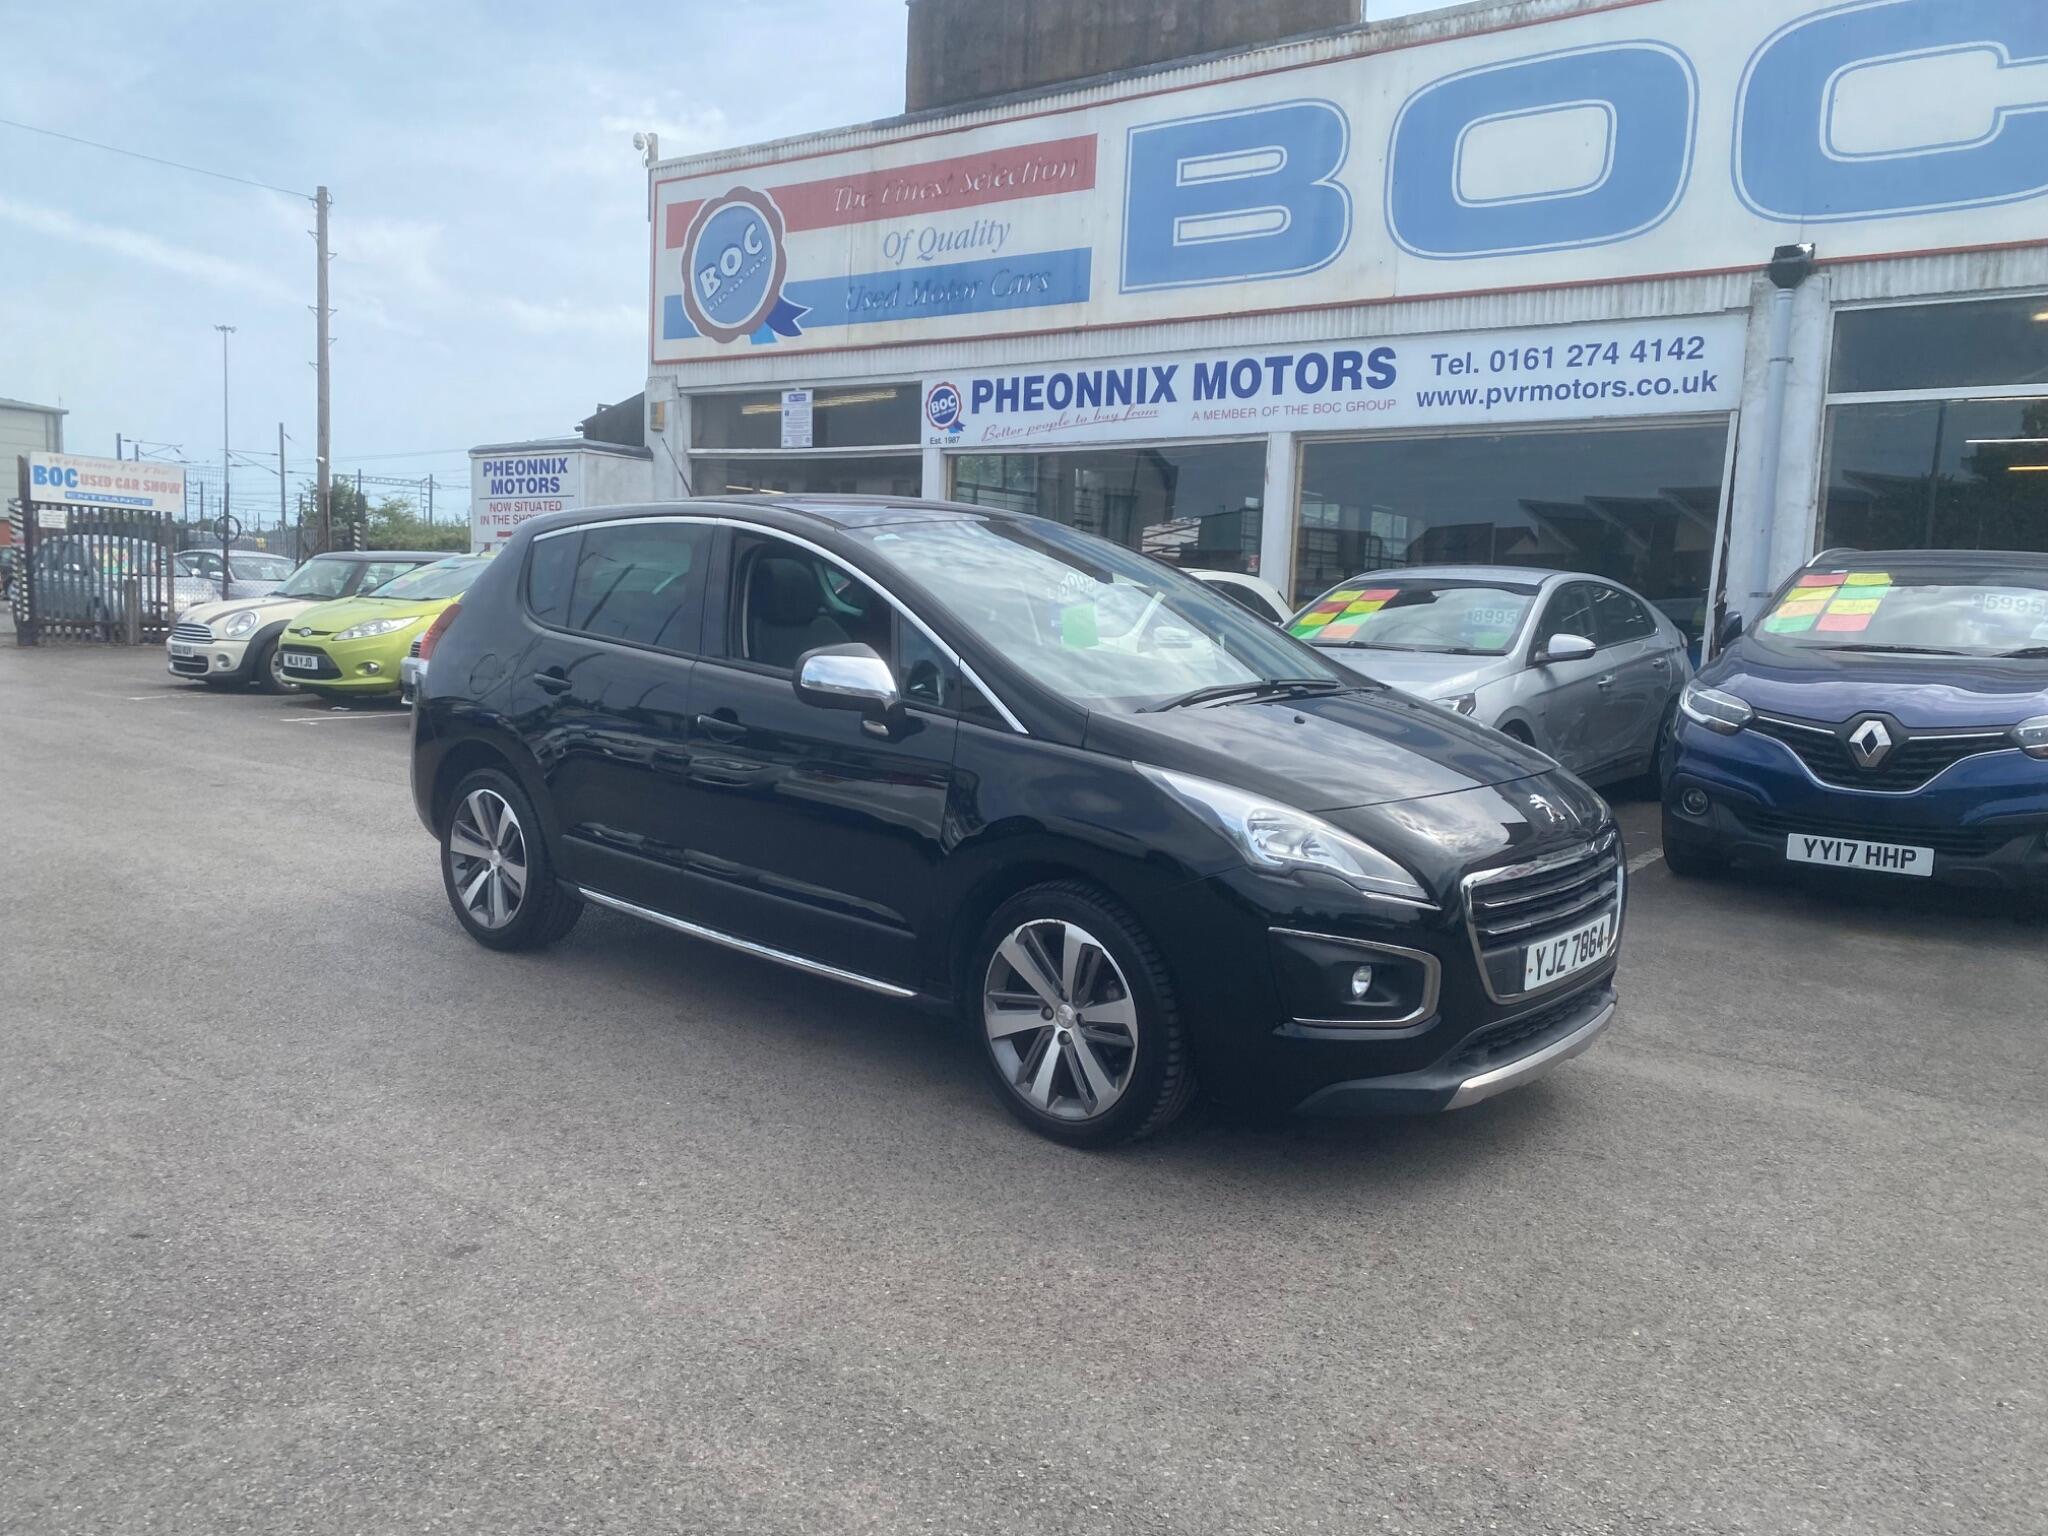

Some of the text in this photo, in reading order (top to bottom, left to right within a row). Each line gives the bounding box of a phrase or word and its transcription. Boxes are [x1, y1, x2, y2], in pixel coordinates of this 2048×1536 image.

[1119, 0, 2048, 294] BOC
[883, 219, 1011, 265] Of Quality
[700, 222, 763, 299] BOC
[991, 268, 1050, 298] Cars
[1431, 335, 1705, 376] Tel. 0161 274 4142
[971, 347, 1397, 414] PHEONNIX MOTORS
[1416, 369, 1718, 409] www.pvrmotors.co.uk
[931, 395, 956, 414] BOC
[1191, 399, 1397, 421] A MEMBER OF THE BOC GROUP
[981, 403, 1159, 442] Better people to buy from
[33, 465, 181, 495] BOC USED CAR SHOW
[483, 457, 569, 477] PHEONNIX
[491, 477, 561, 495] MOTORS
[480, 516, 490, 526] IN
[492, 515, 510, 525] THE
[489, 500, 562, 513] NOW SITUATED
[1804, 837, 1917, 869] YY17 HHP
[1536, 921, 1606, 981] YJZ 7864
